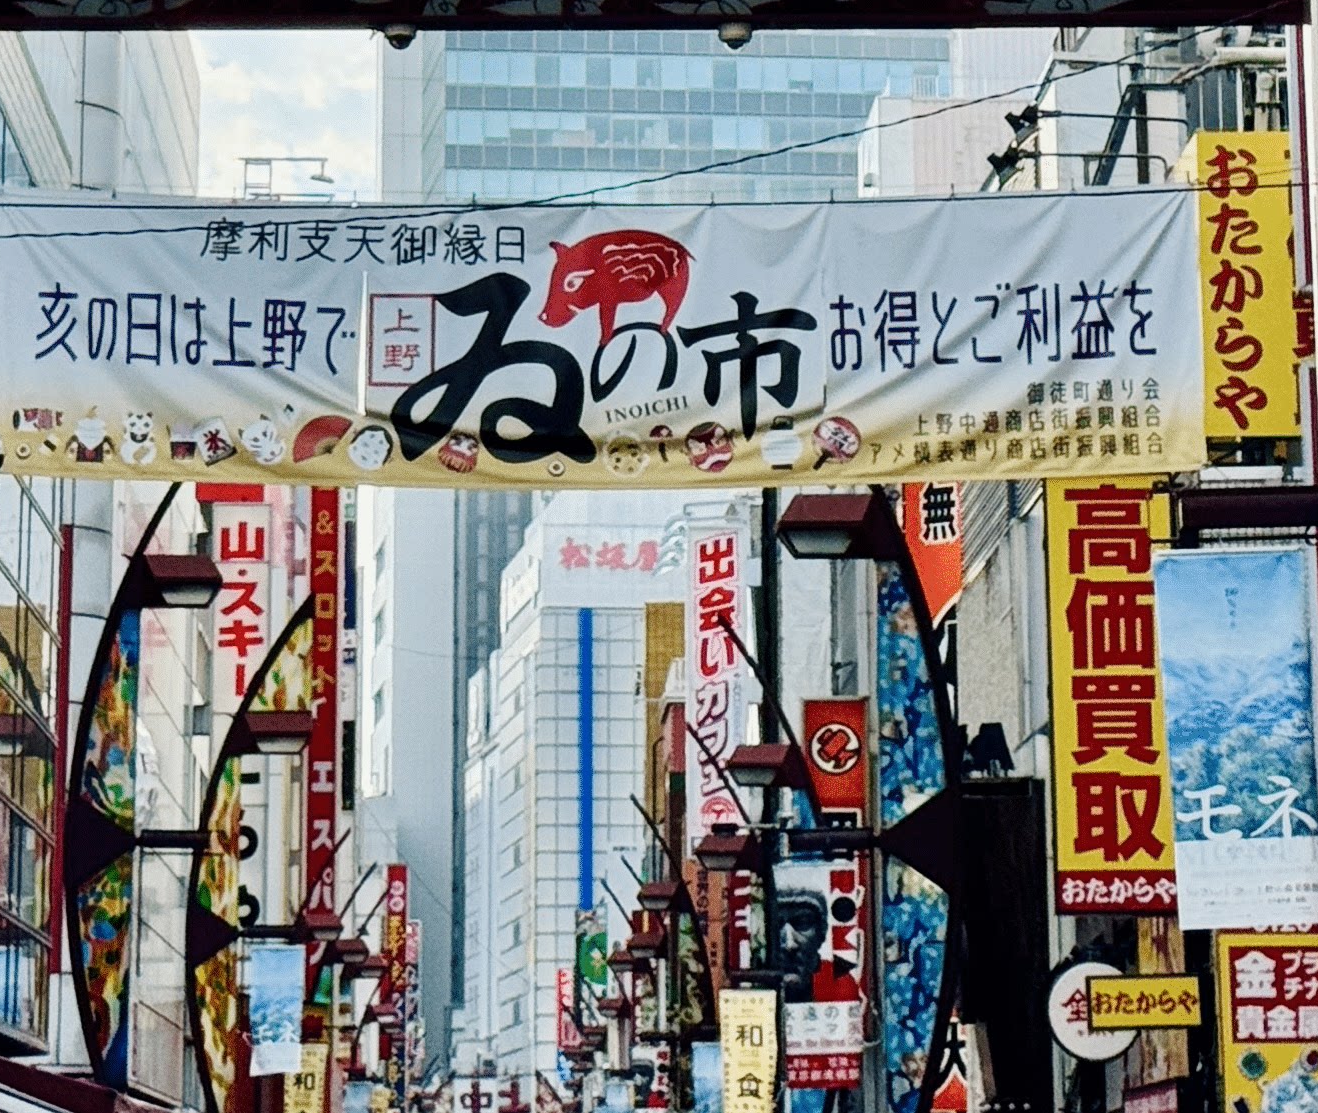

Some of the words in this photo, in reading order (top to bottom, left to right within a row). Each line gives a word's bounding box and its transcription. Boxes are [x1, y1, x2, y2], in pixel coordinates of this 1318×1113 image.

[199, 218, 527, 265] 摩利支天御縁日
[1206, 145, 1269, 430] おたからや
[34, 282, 357, 376] 亥の日は上野で
[382, 306, 422, 372] 上野
[828, 279, 1159, 372] お得とご利益を
[605, 394, 690, 425] INOICHI
[1026, 377, 1162, 406] 御徒町通り会
[913, 404, 1163, 438] 上野中通商店街振興組合
[869, 431, 1165, 465] アメ横表通り商店街振興組合
[1064, 484, 1168, 863] 高価買取
[1178, 774, 1318, 841] モネ
[1061, 876, 1177, 906] おたからや
[1233, 950, 1278, 999] 金
[1092, 989, 1199, 1015] おたからや
